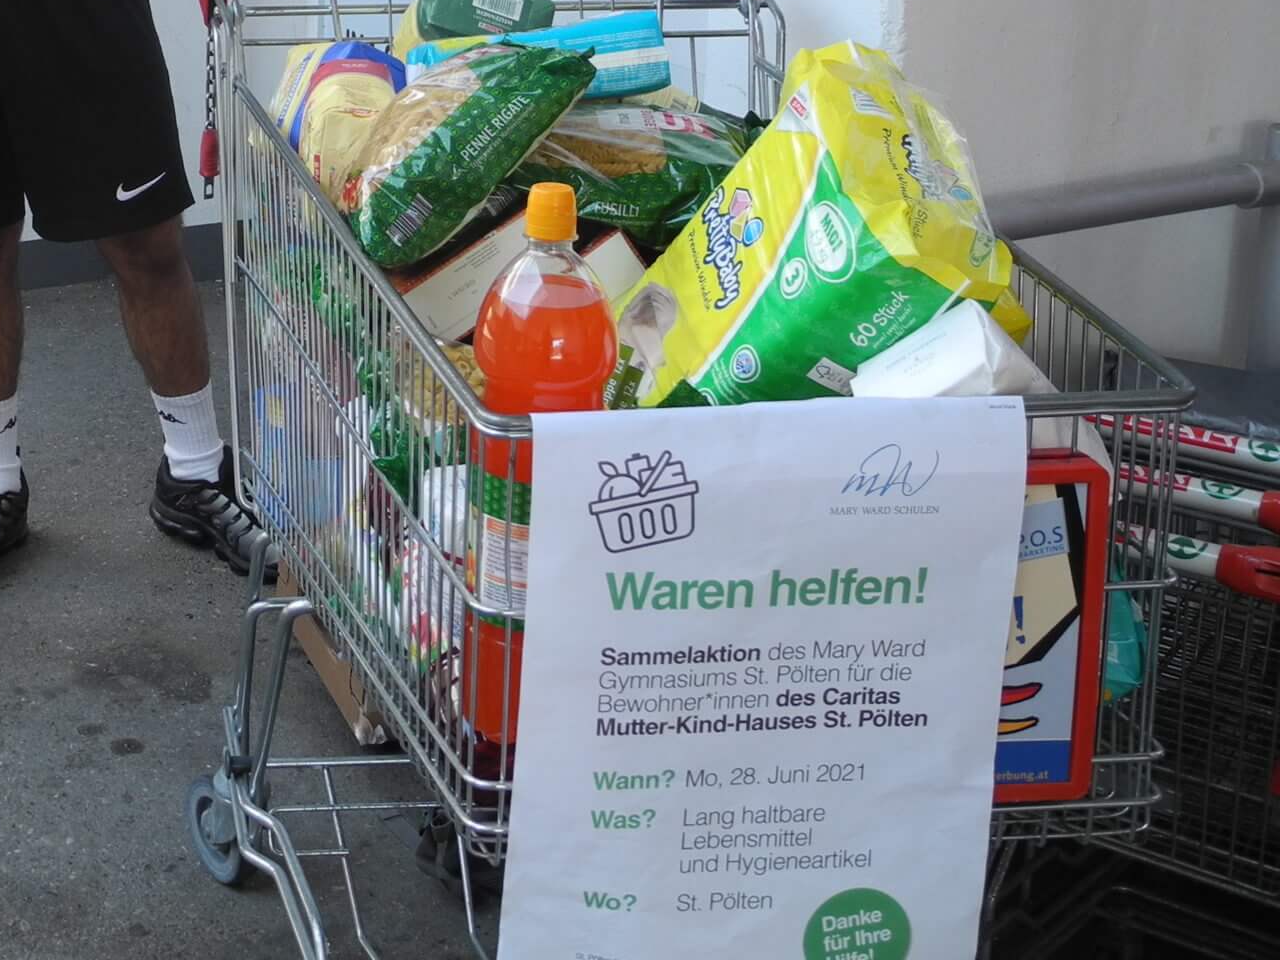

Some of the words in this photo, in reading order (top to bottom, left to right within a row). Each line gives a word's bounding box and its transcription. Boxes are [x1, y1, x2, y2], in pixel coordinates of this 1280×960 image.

[460, 125, 497, 162] PENNE
[491, 95, 531, 130] RIGATE
[849, 322, 877, 347] 60
[829, 506, 859, 516] MARY
[862, 505, 892, 516] WARD
[894, 504, 941, 515] SCHULEN
[606, 571, 754, 611] Waren
[769, 567, 929, 608] helfen!
[600, 644, 761, 667] Sammelaktion
[768, 642, 806, 661] des
[812, 640, 865, 663] Mary
[871, 639, 926, 658] Ward
[599, 668, 738, 694] Gymnasiums
[743, 666, 769, 686] St.
[777, 664, 840, 684] Pölten
[847, 662, 875, 682] für
[880, 662, 913, 681] die
[776, 688, 816, 708] des
[822, 686, 901, 706] Caritas
[596, 713, 817, 737] Mutter-Kind-Hauses
[823, 710, 853, 729] St.
[858, 709, 929, 728] Pölten
[593, 770, 676, 791] Wann?
[685, 769, 723, 789] Mo,
[729, 767, 761, 786] 28.
[767, 765, 811, 784] Juni
[816, 763, 866, 783] 2021
[591, 809, 657, 830] Was?
[682, 808, 735, 829] Lang
[741, 805, 826, 825] haltbare
[680, 828, 813, 851] Lebensmittel
[679, 854, 719, 874] und
[725, 849, 872, 876] Hygieneartikel
[583, 891, 638, 912] Wo?
[676, 894, 702, 912] St.
[709, 892, 773, 911] Pölten
[822, 908, 883, 932] Danke
[823, 932, 851, 952] für
[855, 927, 893, 948] Ihre
